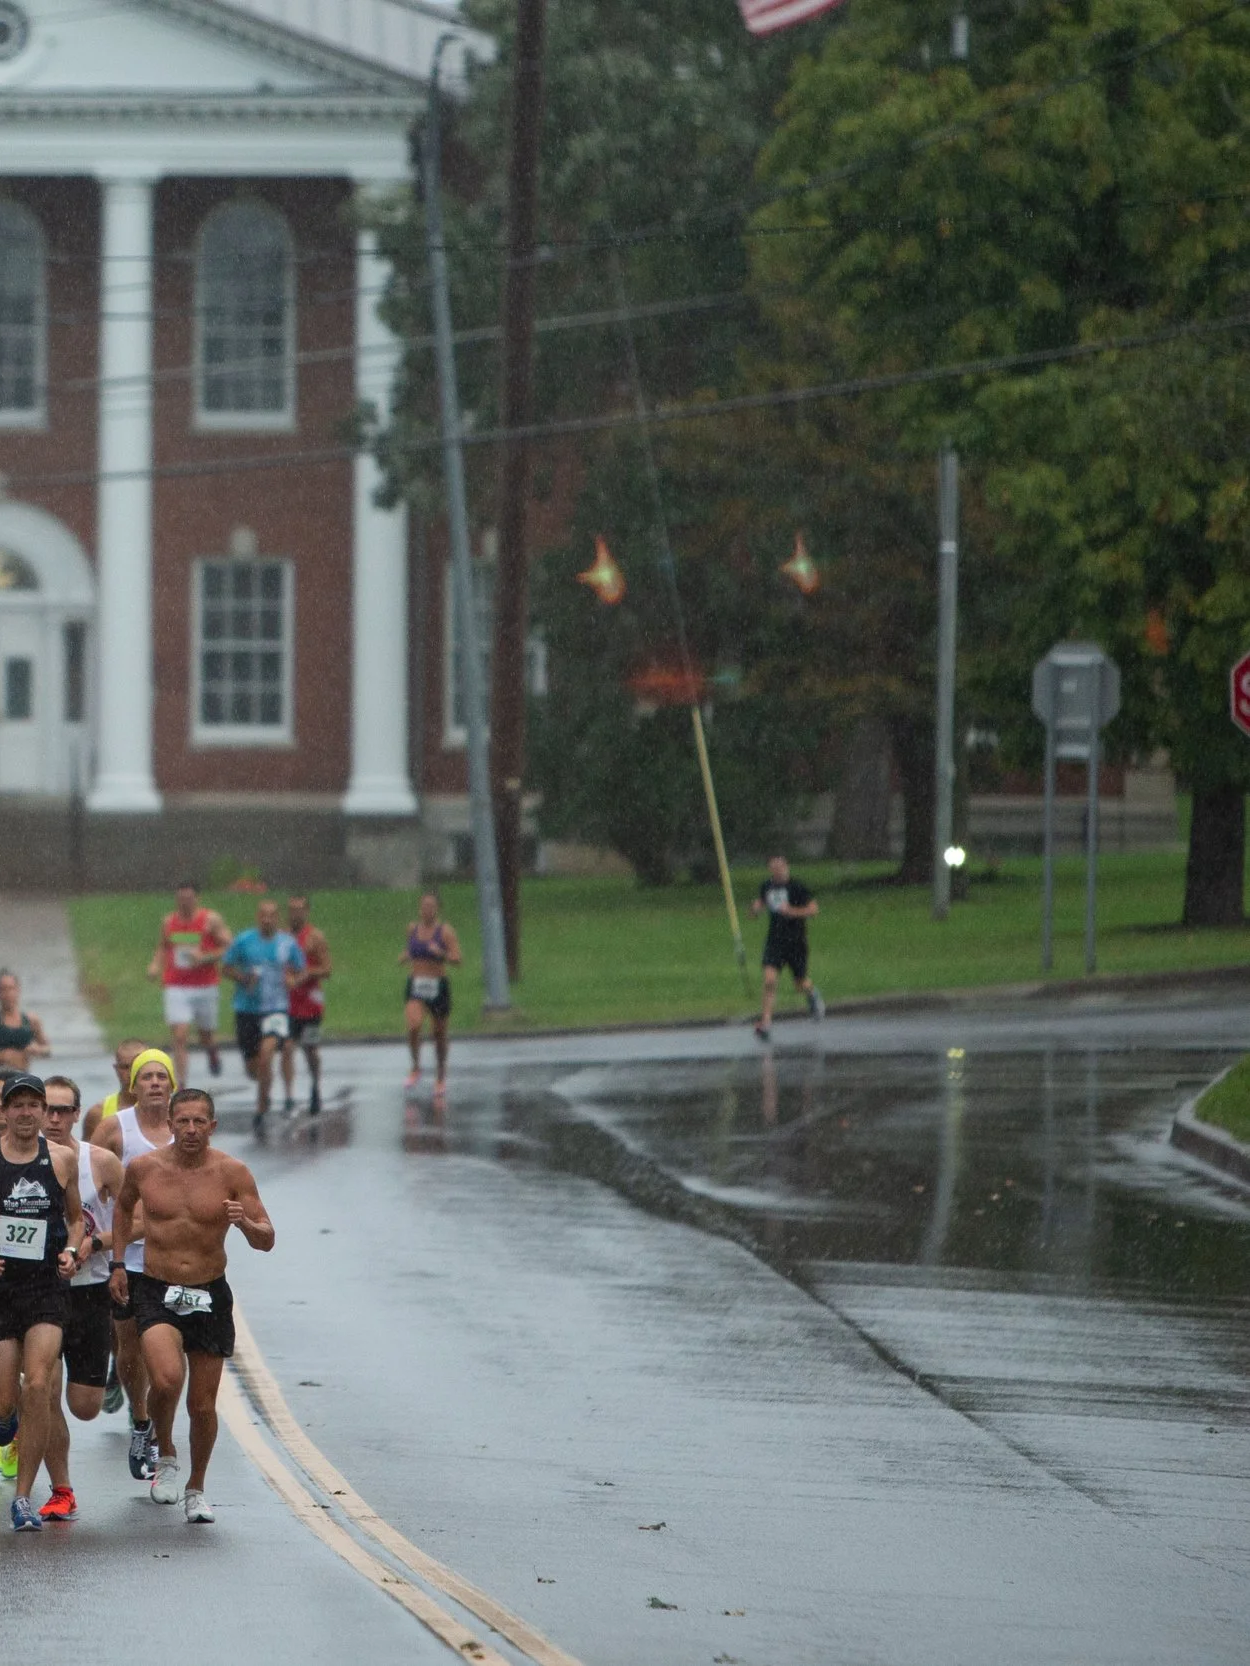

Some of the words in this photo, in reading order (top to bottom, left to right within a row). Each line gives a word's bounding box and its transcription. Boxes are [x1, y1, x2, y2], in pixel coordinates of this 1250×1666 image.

[3, 1199, 19, 1208] Blue
[20, 1197, 51, 1207] Mountain
[6, 1224, 38, 1245] 327
